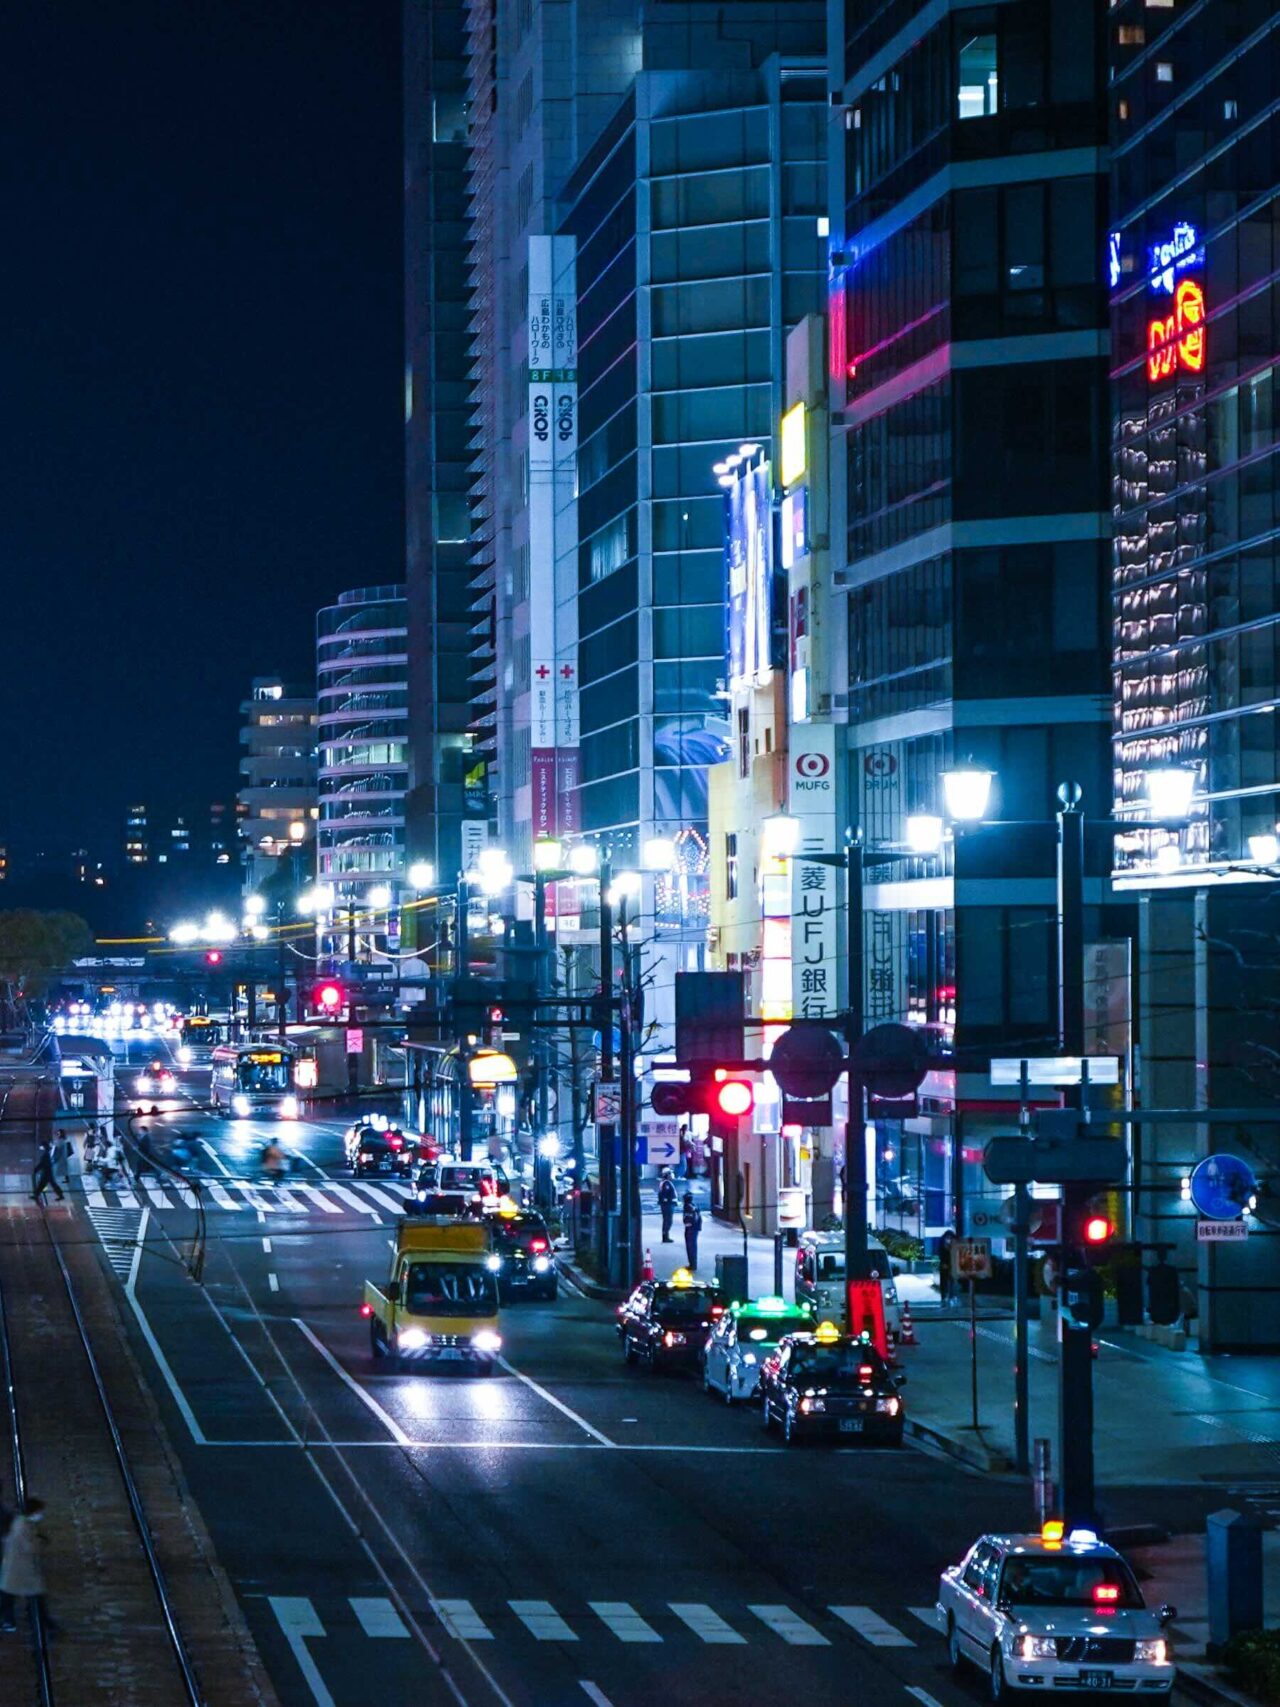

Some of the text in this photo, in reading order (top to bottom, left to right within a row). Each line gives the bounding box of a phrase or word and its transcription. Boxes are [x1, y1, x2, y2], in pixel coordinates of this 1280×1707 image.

[531, 371, 551, 381] 8F
[534, 394, 549, 442] GROP
[796, 781, 830, 791] MUFG
[801, 838, 827, 1019] 三菱UFJ銀行
